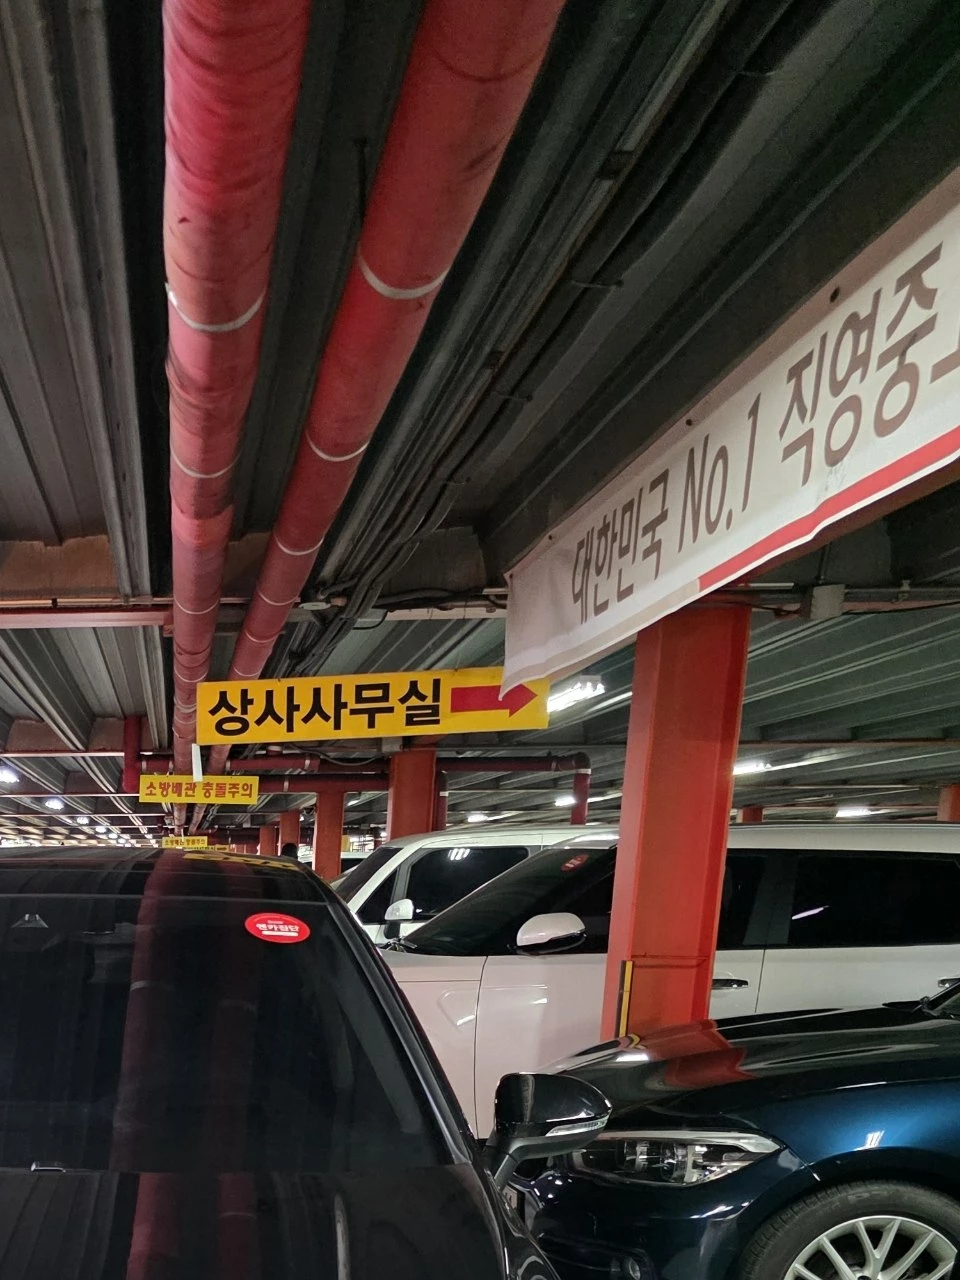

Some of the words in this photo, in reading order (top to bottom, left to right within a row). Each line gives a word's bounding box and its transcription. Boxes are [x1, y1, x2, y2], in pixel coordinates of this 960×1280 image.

[571, 468, 670, 625] 대한민국
[677, 392, 762, 553] No.1
[778, 241, 960, 488] 직영중
[208, 678, 442, 737] 상사사무실
[145, 782, 197, 798] 소방배관
[202, 782, 253, 798] 충돌주의
